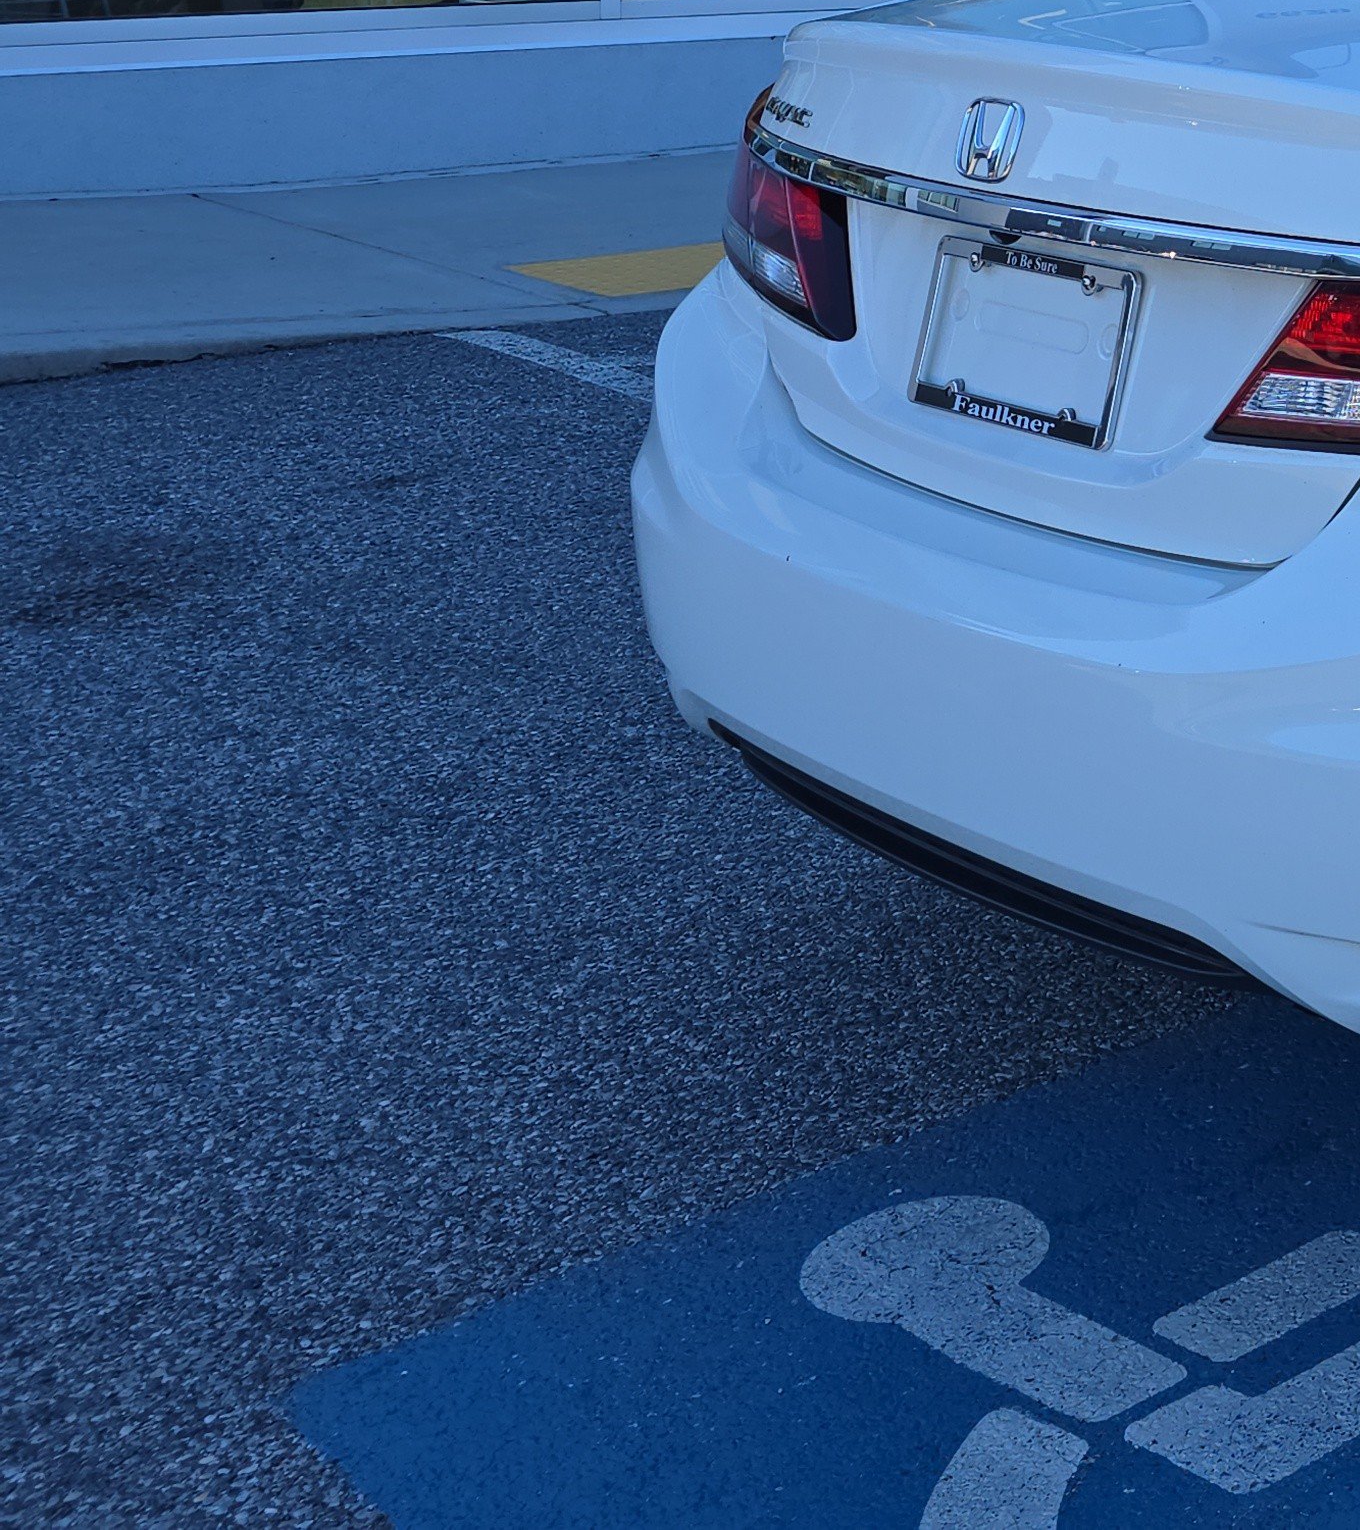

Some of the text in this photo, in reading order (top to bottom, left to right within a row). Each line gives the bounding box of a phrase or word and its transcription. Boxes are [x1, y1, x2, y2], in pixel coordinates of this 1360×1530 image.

[1005, 250, 1058, 274] To Be Sure
[951, 393, 1056, 435] Faulkner
